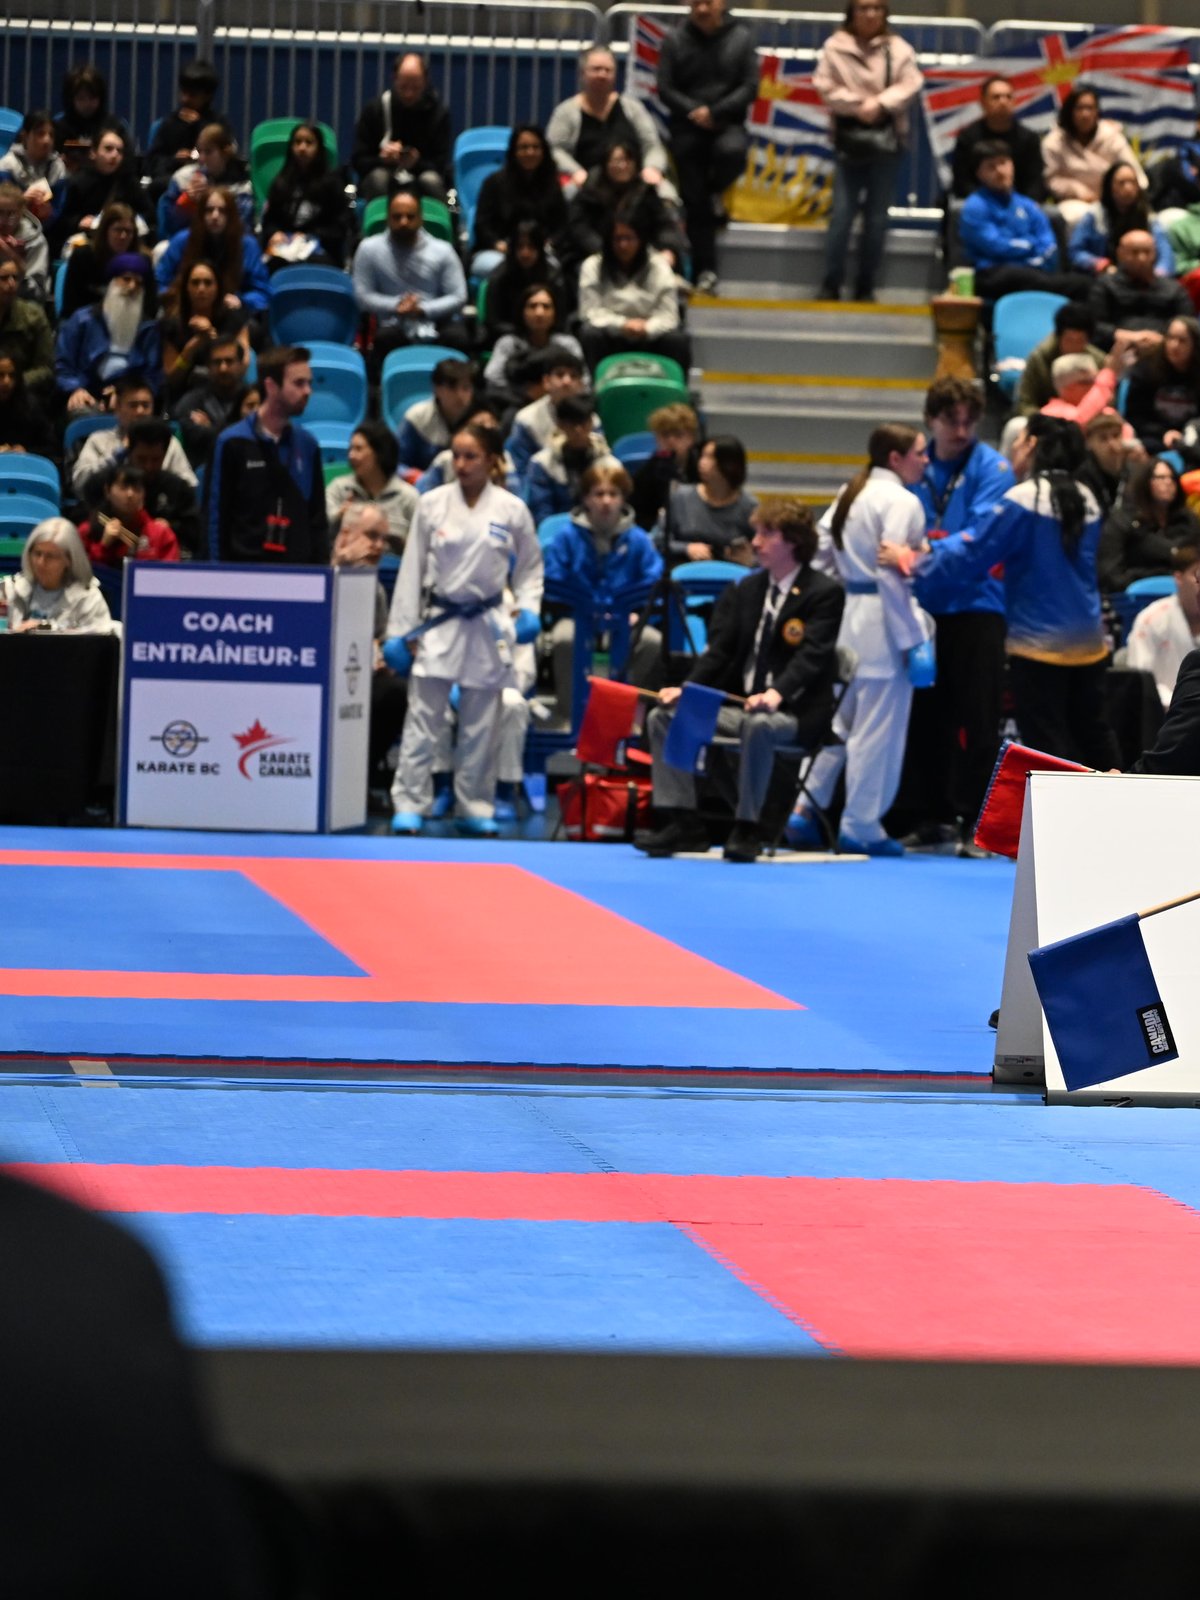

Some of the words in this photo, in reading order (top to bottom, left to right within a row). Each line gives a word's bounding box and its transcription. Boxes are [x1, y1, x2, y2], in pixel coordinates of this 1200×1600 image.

[182, 611, 274, 633] COACH
[132, 639, 317, 667] ENTRAÎNEUR·E
[259, 753, 312, 764] KARATE
[136, 761, 196, 774] KARATE
[200, 763, 221, 775] BC
[259, 765, 312, 778] CANADA
[1142, 1009, 1165, 1053] CANADA
